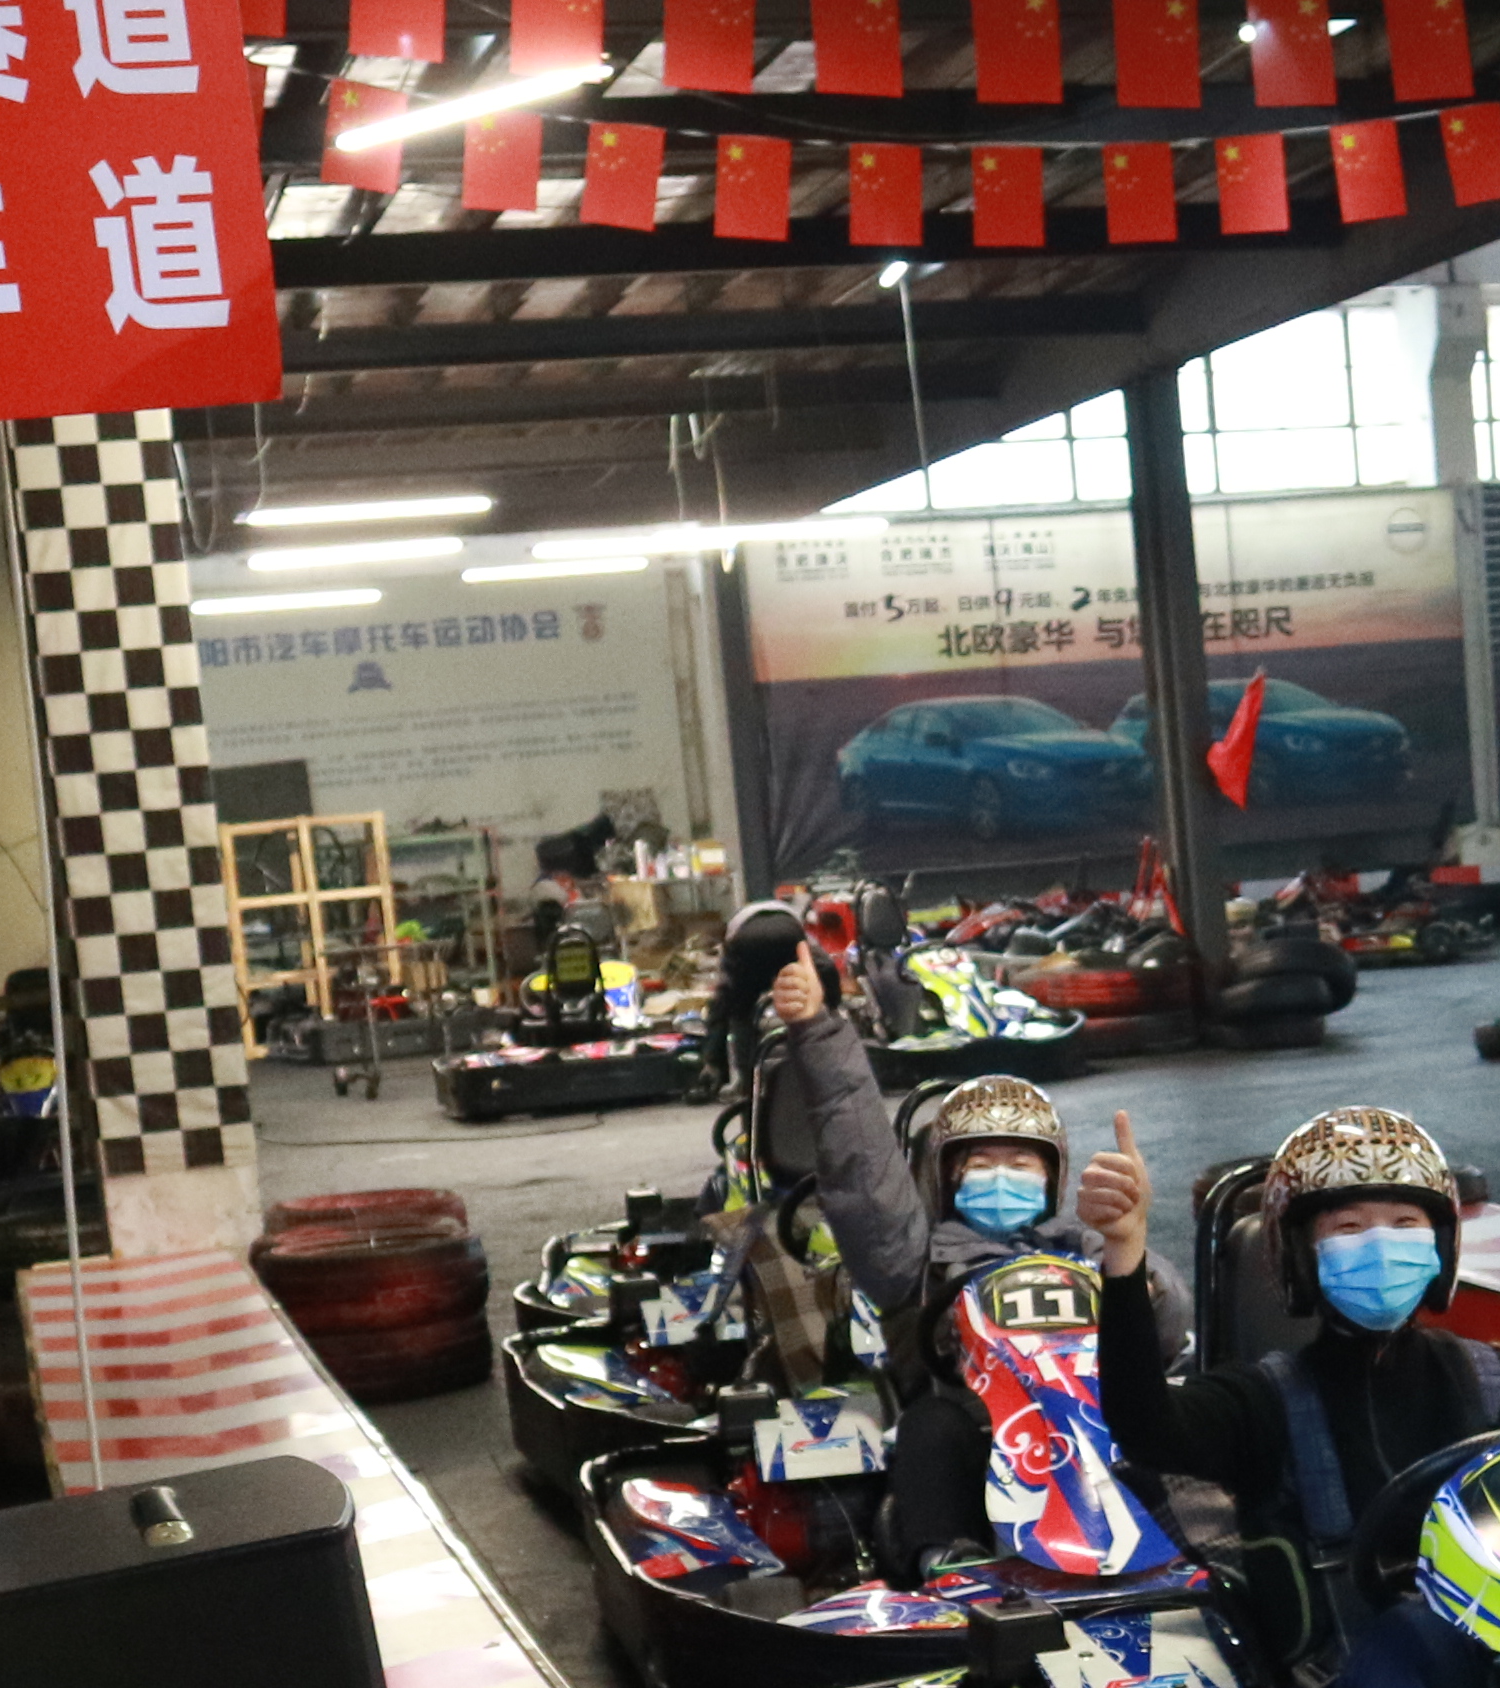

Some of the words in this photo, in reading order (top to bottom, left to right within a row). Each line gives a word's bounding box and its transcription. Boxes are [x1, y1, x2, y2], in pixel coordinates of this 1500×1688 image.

[937, 618, 1076, 659] 北欧豪华
[1002, 1287, 1090, 1327] 11
